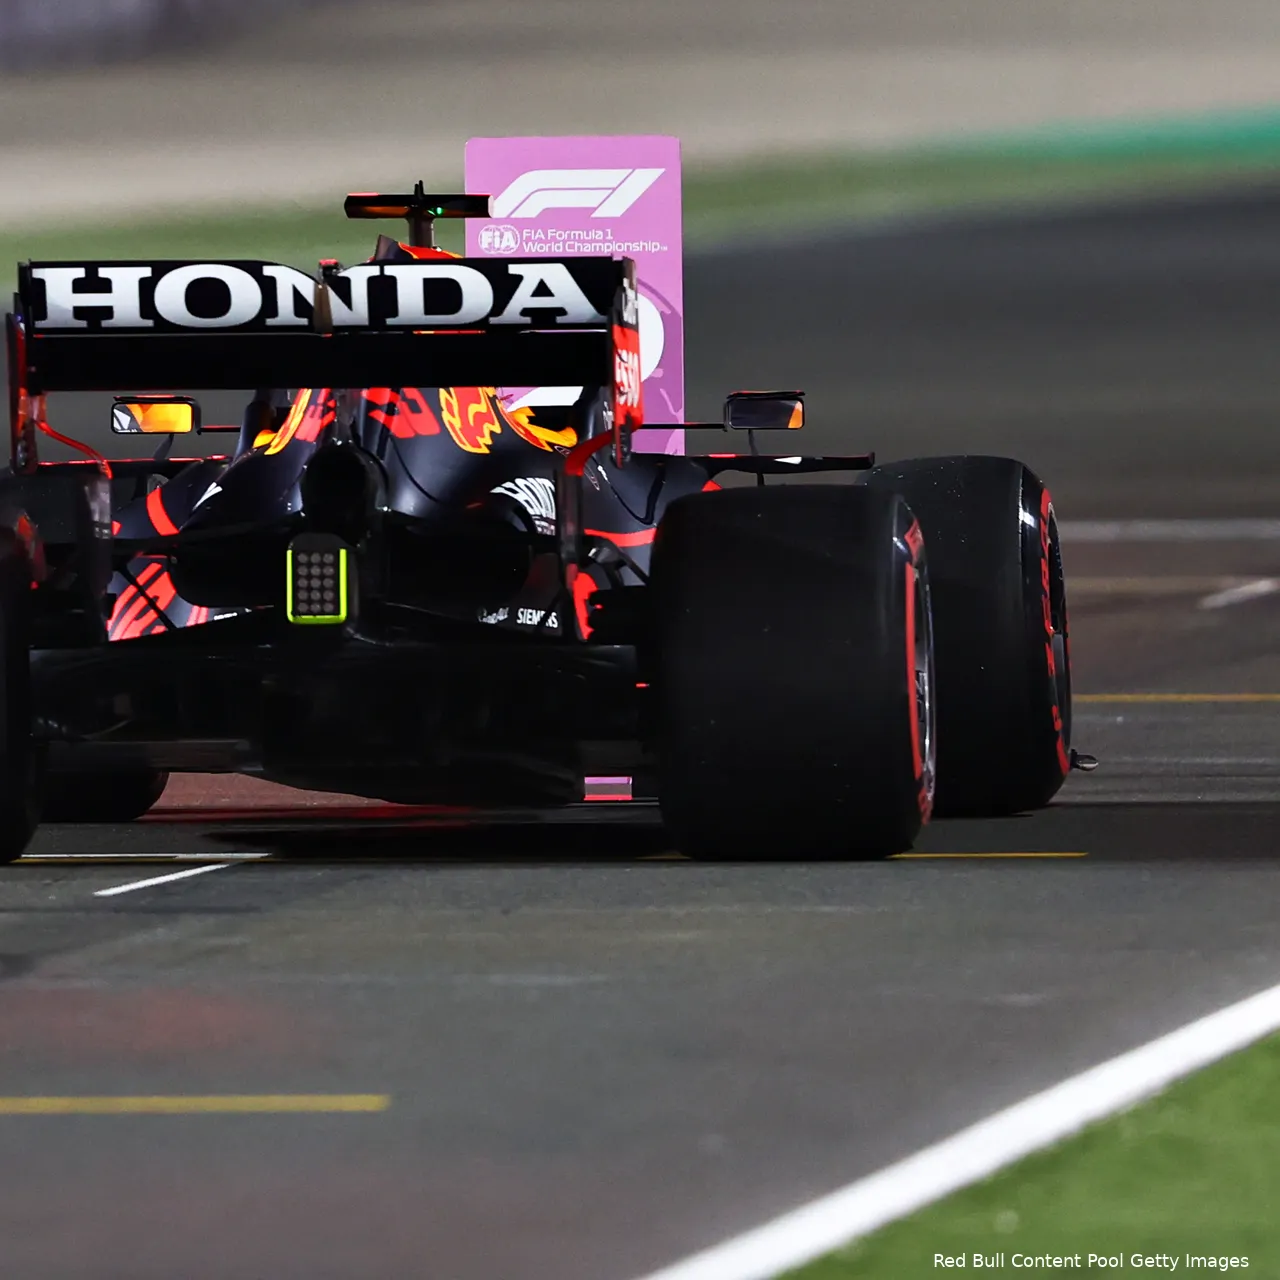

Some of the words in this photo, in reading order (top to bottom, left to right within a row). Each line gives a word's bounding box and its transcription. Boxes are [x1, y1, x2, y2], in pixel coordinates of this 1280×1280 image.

[522, 229, 546, 240] FIA
[547, 228, 604, 240] Formula
[605, 228, 613, 240] 1
[522, 241, 563, 253] World
[32, 262, 607, 328] HONDA
